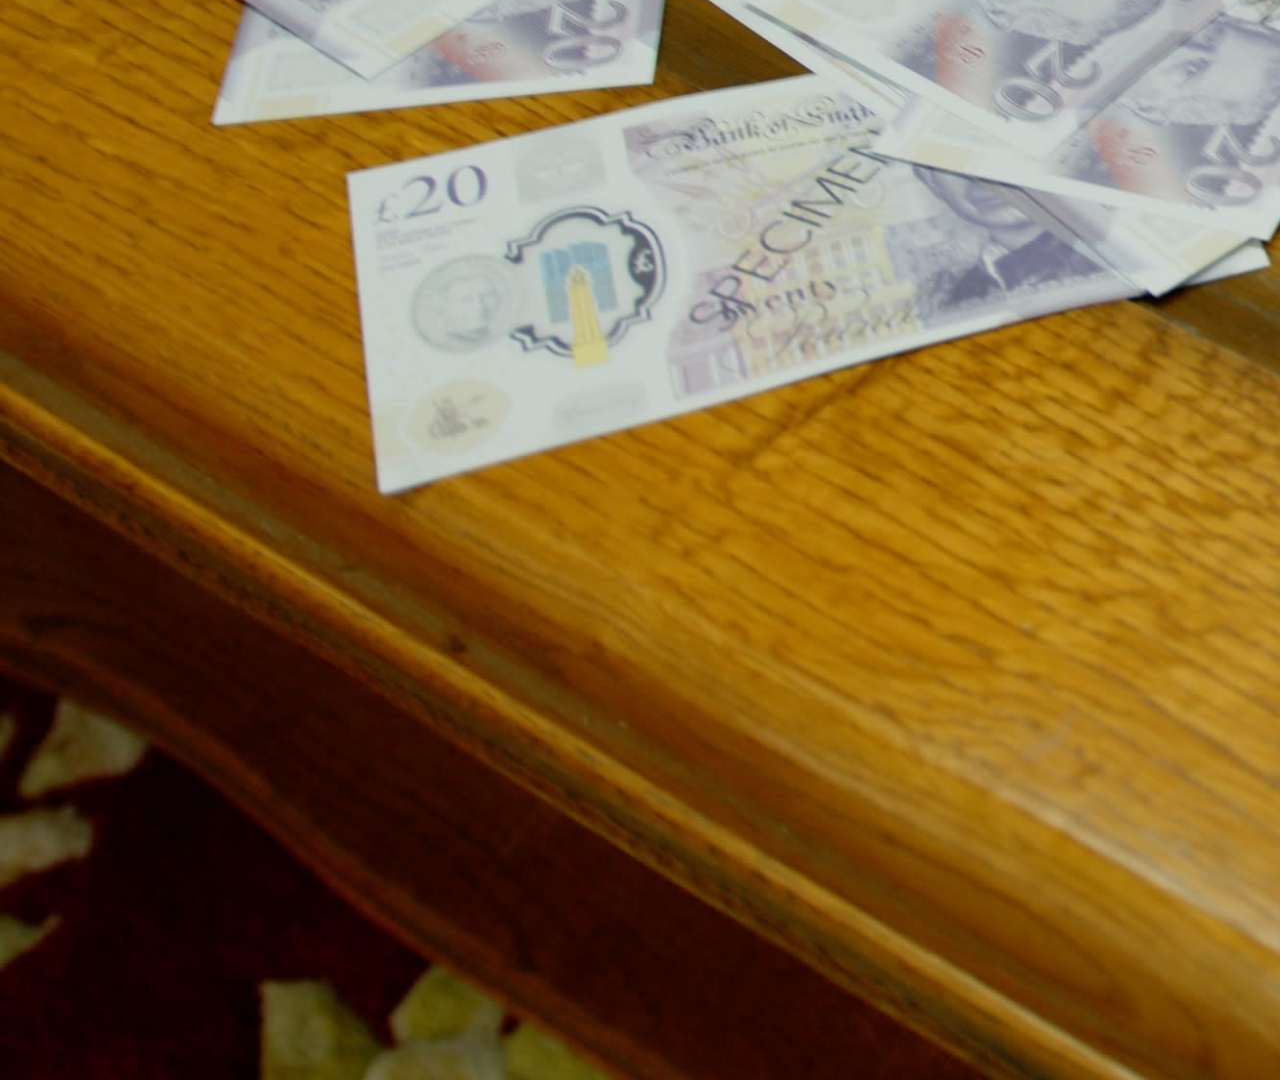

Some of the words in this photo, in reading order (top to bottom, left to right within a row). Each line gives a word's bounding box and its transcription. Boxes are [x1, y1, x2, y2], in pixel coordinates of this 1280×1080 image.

[992, 38, 1102, 122] 20
[377, 164, 488, 223] £20
[690, 128, 890, 334] SPECIMEN
